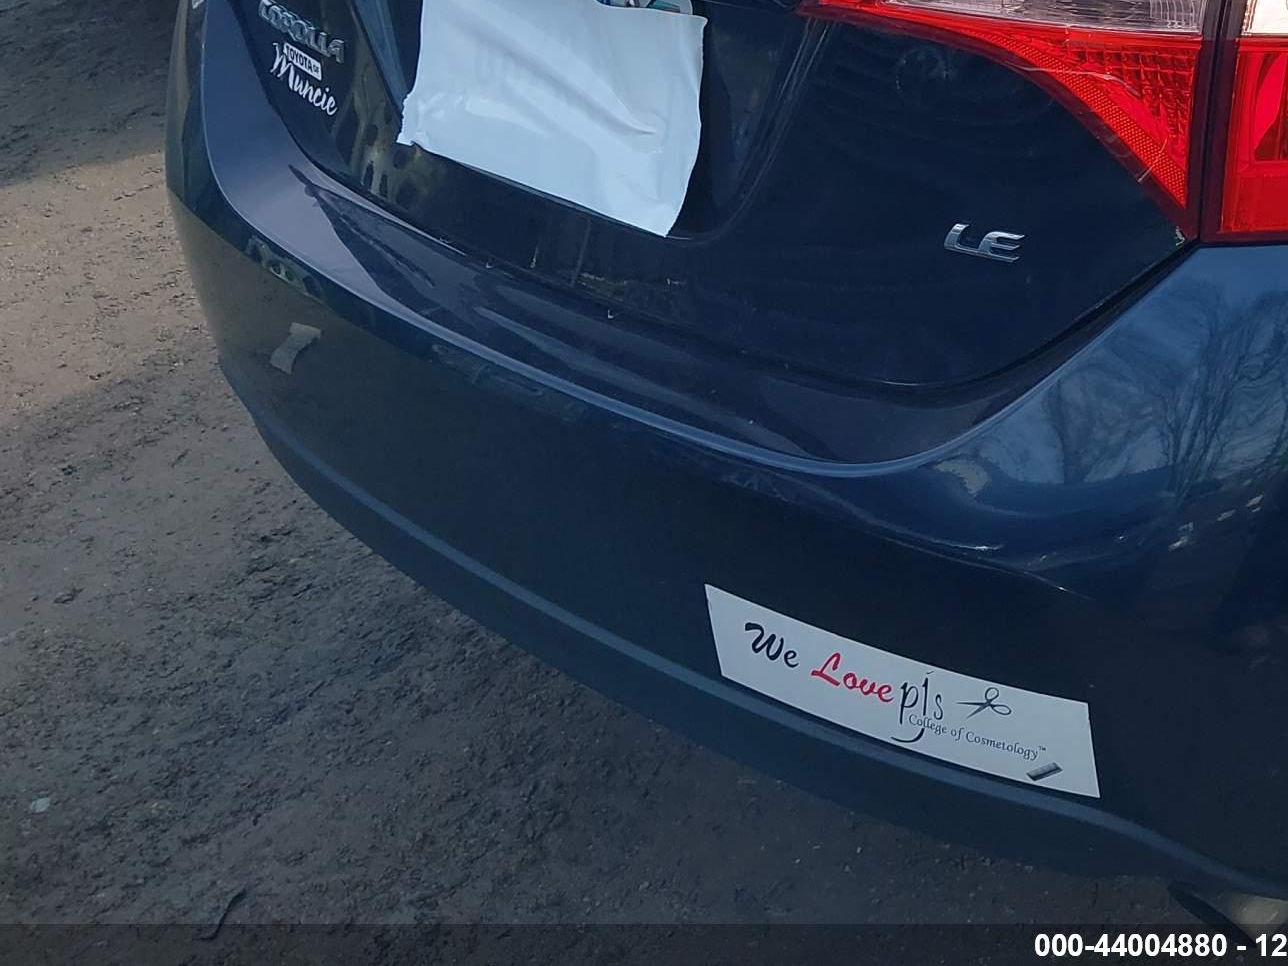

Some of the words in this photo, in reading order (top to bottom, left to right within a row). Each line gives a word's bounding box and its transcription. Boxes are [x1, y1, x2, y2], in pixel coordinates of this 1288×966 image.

[270, 42, 338, 115] Muncie
[944, 223, 1025, 263] LE
[744, 622, 800, 668] We
[811, 652, 895, 703] Love
[908, 713, 948, 736] College
[950, 727, 965, 741] of
